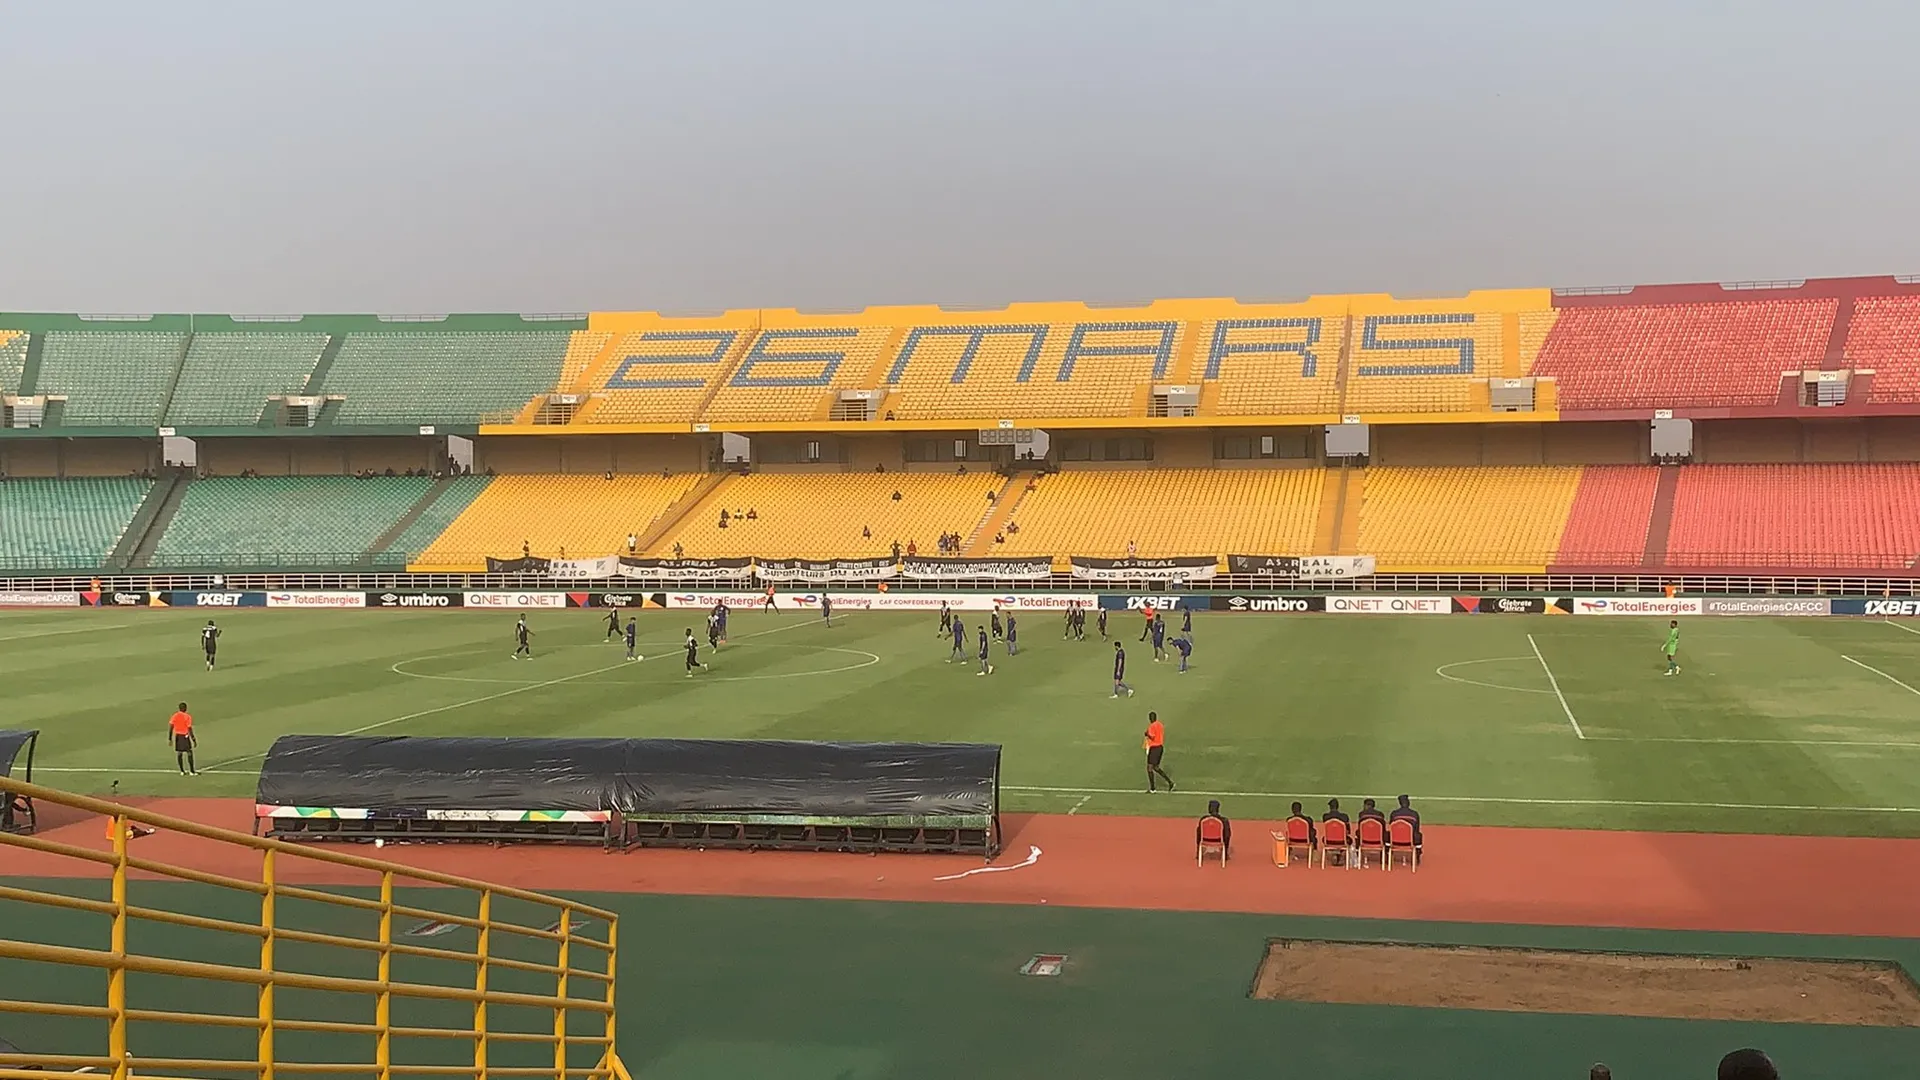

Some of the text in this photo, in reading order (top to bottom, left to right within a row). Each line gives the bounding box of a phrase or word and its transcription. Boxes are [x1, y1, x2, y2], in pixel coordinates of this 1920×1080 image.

[605, 313, 1475, 388] 26 MARS
[196, 593, 243, 606] 1XBET
[293, 595, 360, 607] TotalEnergies
[399, 593, 449, 606] umbro
[471, 594, 559, 606] QNET QNET
[1250, 597, 1308, 611] umbro
[1334, 599, 1441, 611] QNET QNET
[1610, 601, 1697, 614] TotalEnergies
[1709, 602, 1823, 613] #TotalEnergiesCAFCC
